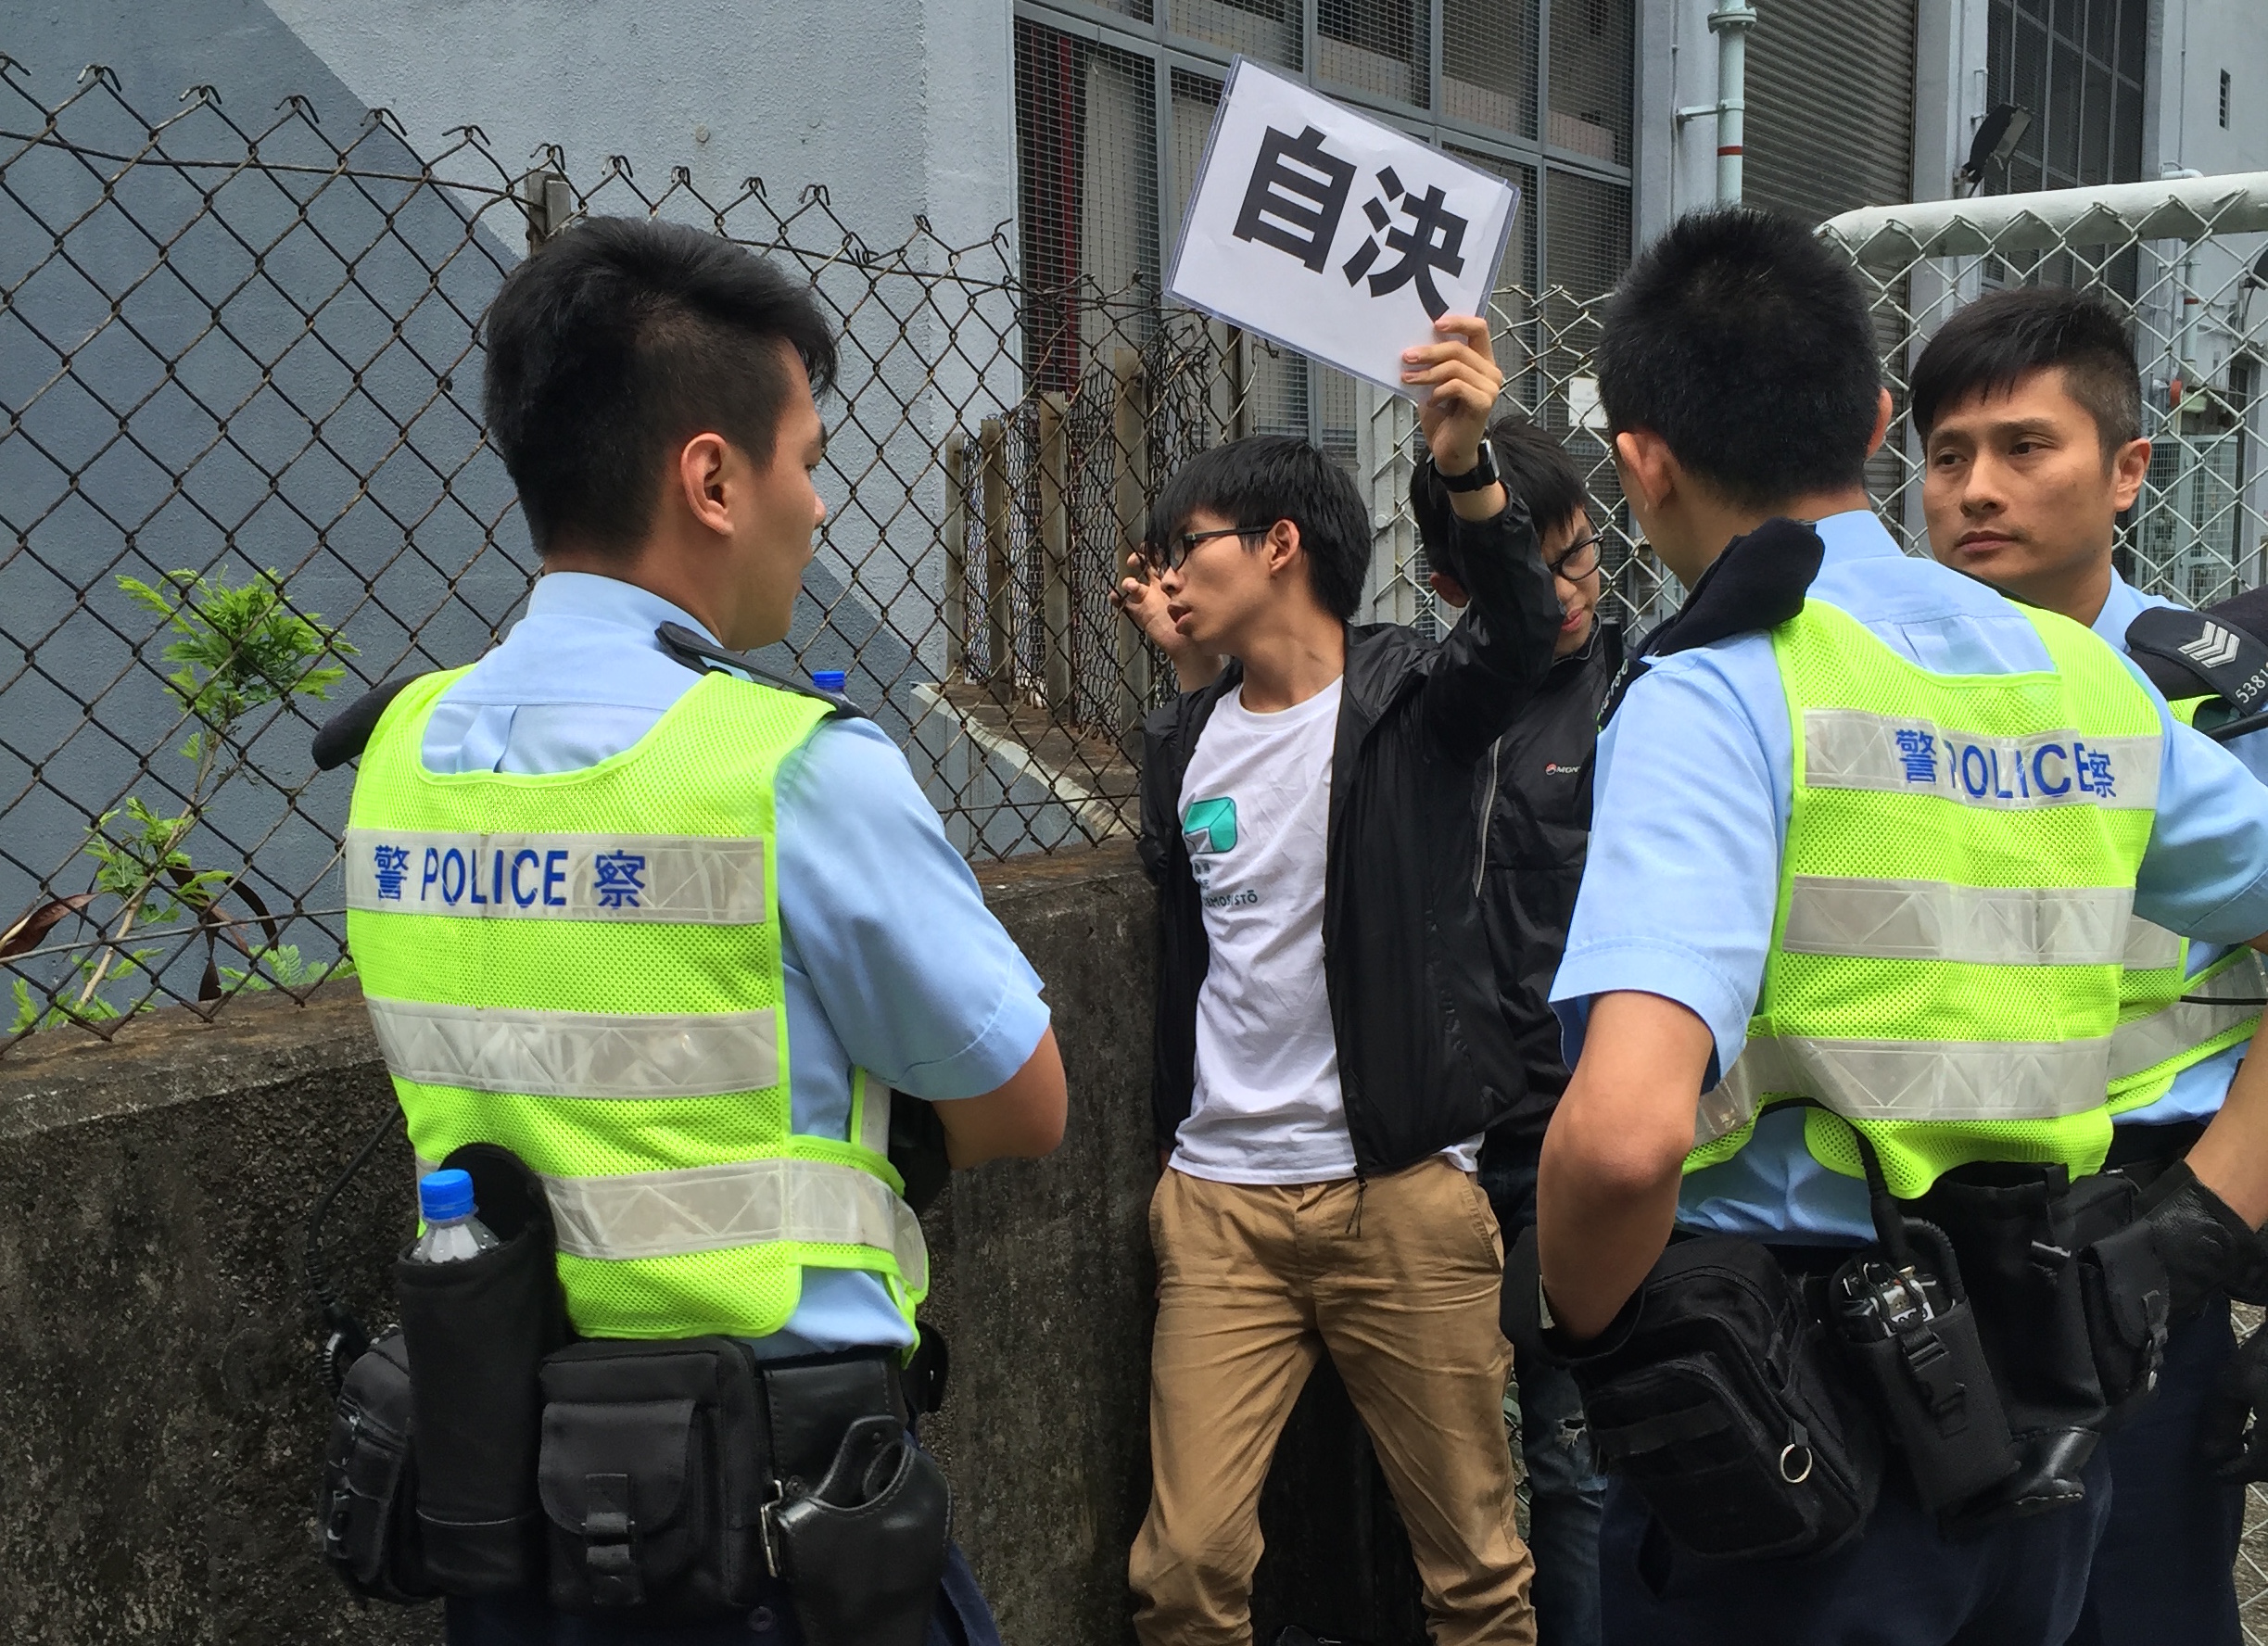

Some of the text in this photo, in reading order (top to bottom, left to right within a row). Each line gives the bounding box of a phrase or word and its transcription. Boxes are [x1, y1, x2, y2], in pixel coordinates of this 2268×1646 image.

[1233, 125, 1469, 322] 自決
[1895, 729, 2117, 799] 警 POLICE 察
[374, 845, 646, 908] 警 POLICE 察
